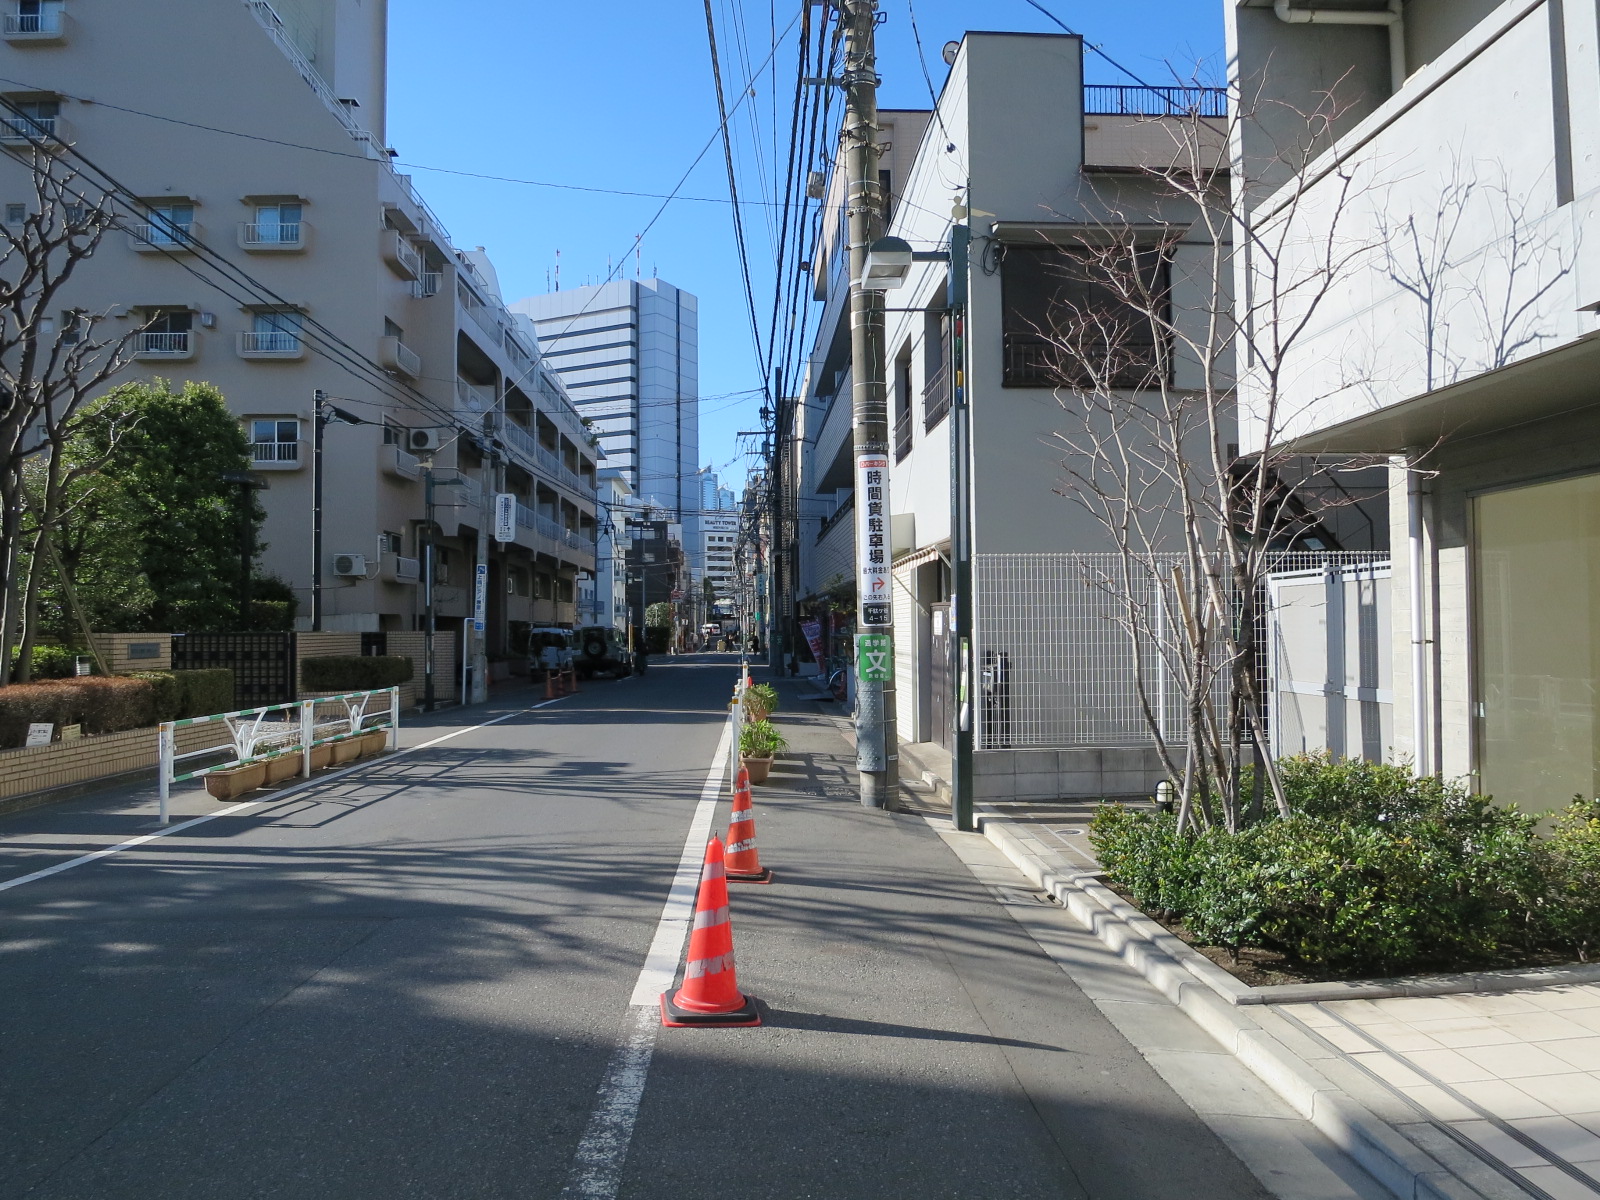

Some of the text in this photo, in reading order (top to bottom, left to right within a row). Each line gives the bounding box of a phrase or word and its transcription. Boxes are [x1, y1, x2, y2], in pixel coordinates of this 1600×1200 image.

[867, 470, 884, 564] 時間貸駐車場
